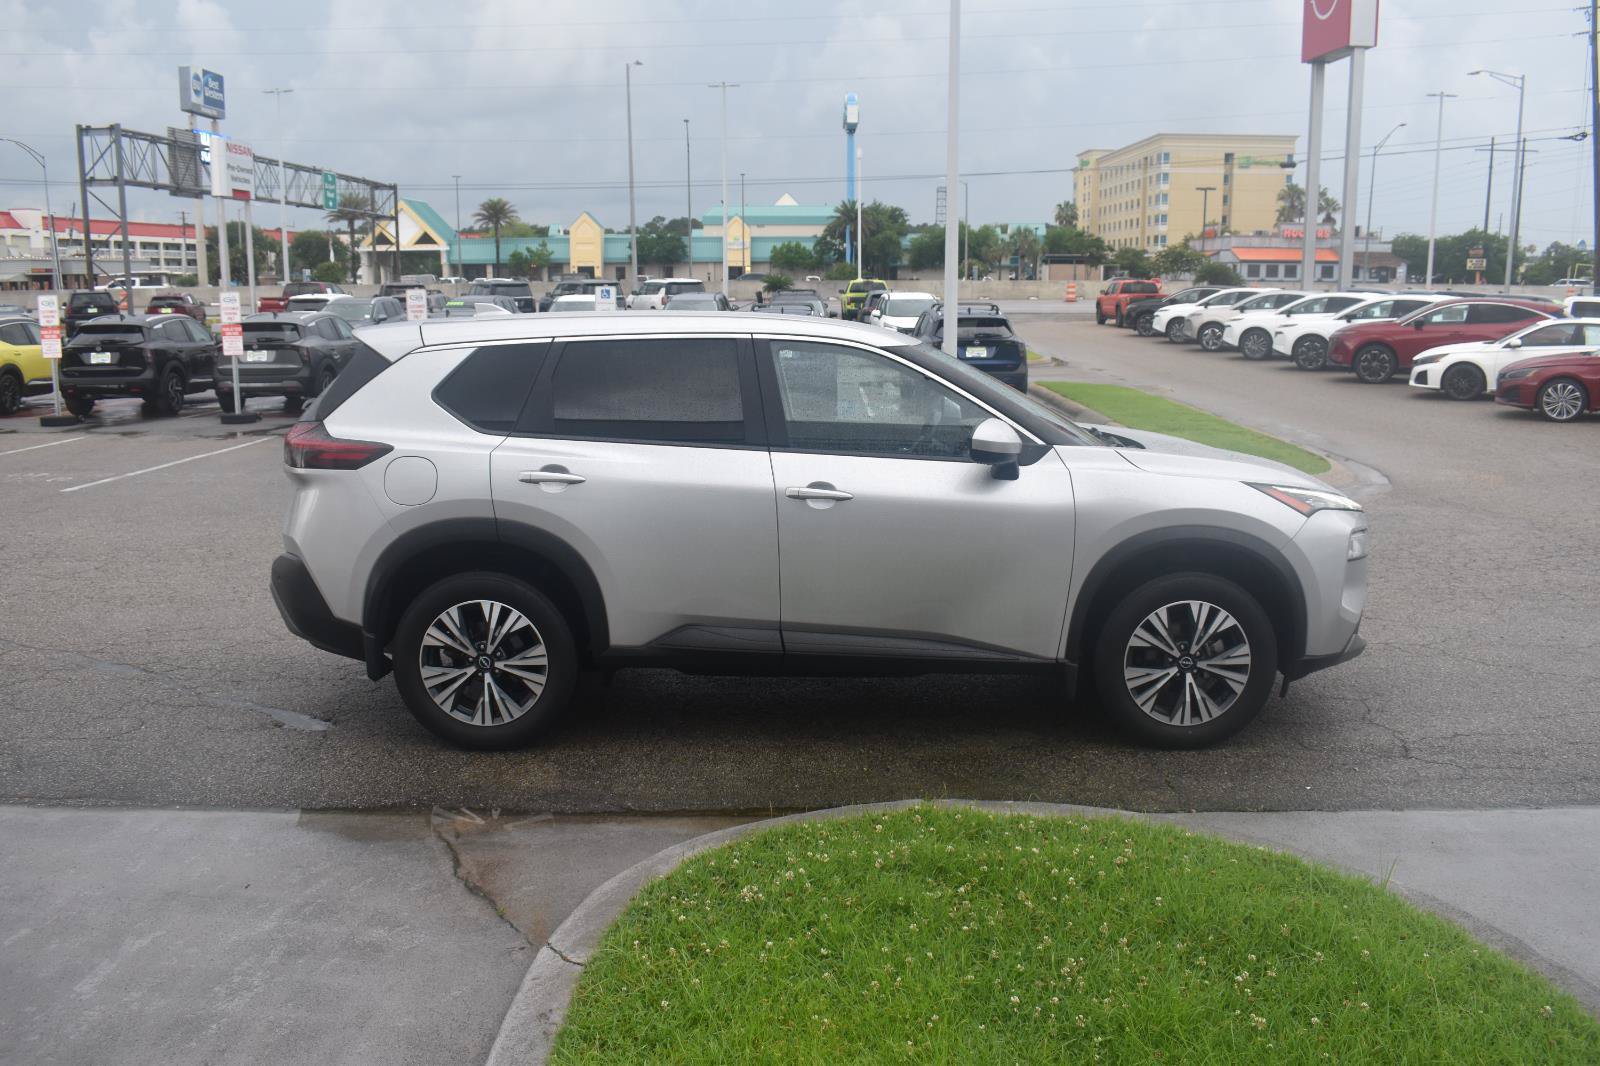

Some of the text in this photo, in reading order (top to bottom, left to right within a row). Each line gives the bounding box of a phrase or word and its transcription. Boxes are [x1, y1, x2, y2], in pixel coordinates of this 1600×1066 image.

[208, 77, 220, 90] Best
[204, 87, 224, 101] Western
[226, 142, 253, 157] NISSAN
[227, 163, 253, 175] Pre-Owned
